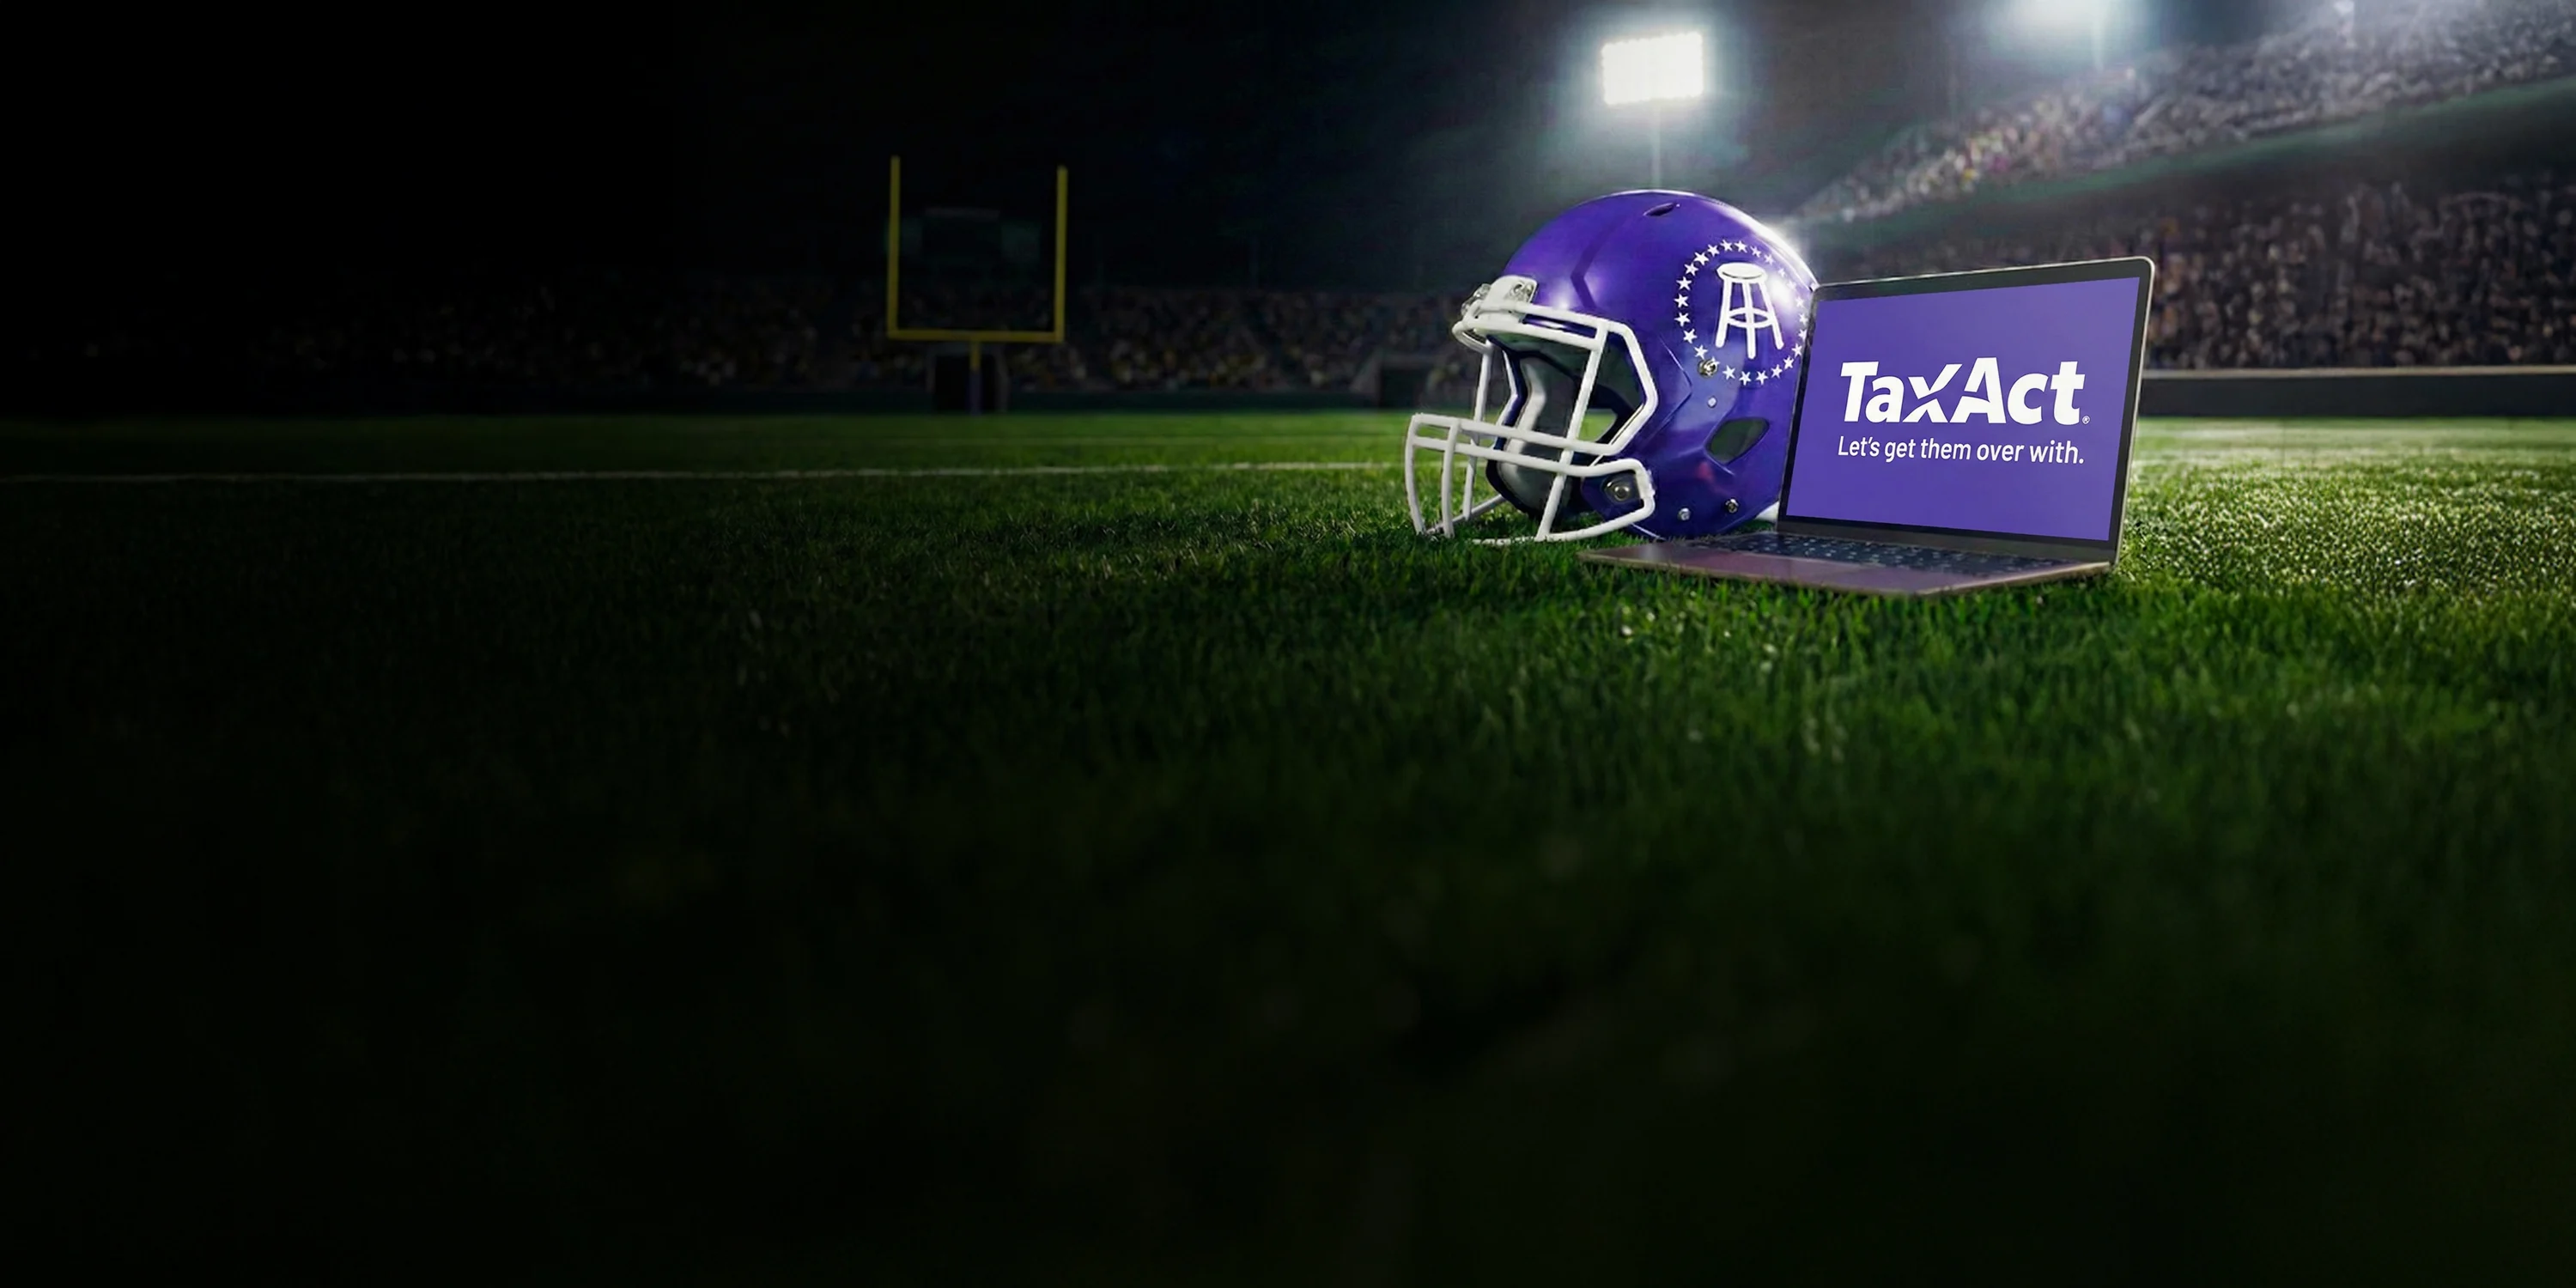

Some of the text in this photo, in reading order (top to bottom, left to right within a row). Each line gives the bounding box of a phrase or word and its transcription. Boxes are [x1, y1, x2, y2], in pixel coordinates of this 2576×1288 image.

[1838, 435, 2084, 465] Let's get them over with.
